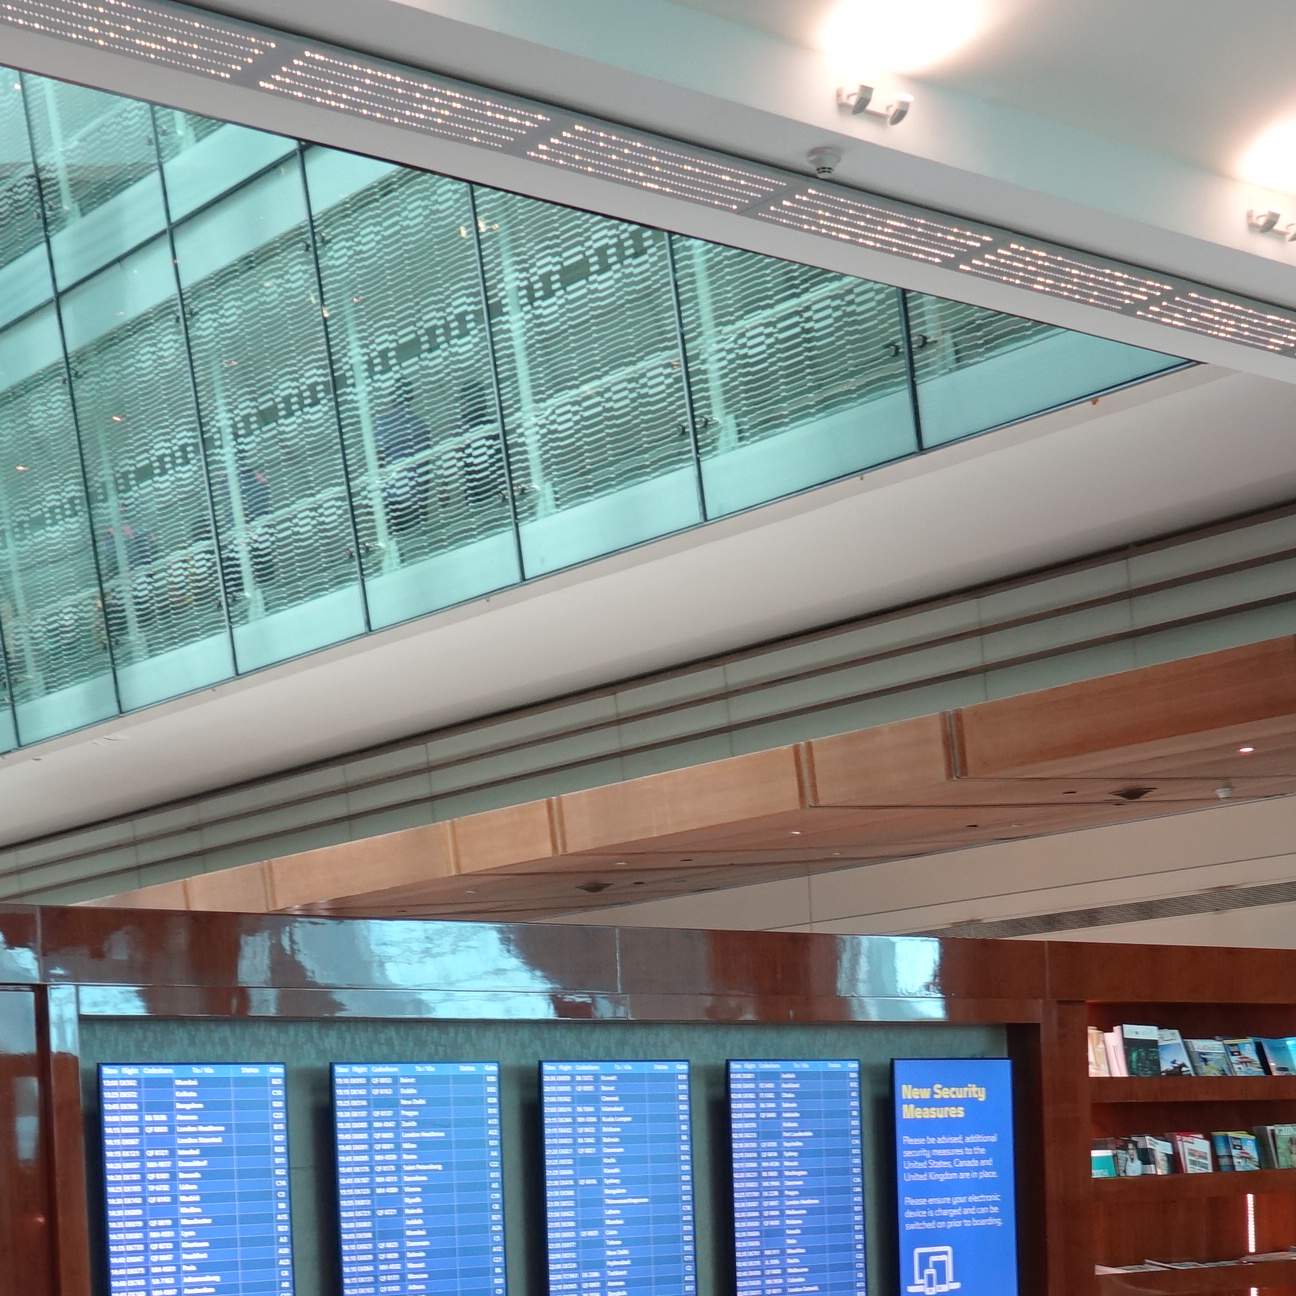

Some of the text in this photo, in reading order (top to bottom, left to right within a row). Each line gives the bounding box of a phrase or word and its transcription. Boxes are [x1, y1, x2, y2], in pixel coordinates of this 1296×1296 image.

[902, 1084, 986, 1101] New Security
[902, 1104, 965, 1119] Measures
[903, 1146, 986, 1158] security measures to the
